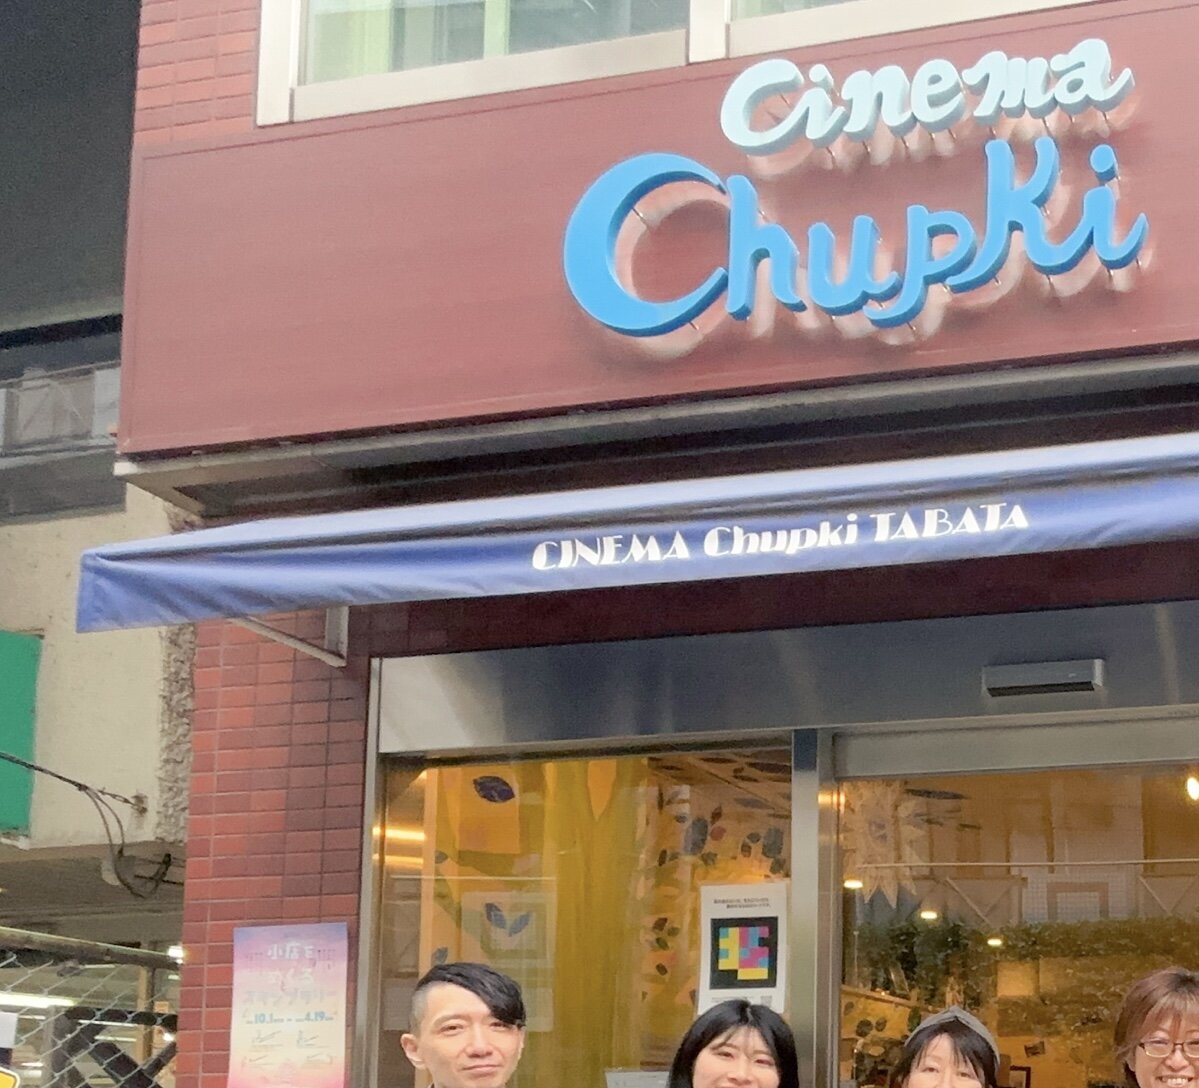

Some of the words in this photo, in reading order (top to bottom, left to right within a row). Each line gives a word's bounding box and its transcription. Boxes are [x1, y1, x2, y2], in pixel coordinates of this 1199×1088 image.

[721, 38, 1134, 155] Cinema
[532, 529, 690, 570] CINEMA
[703, 513, 858, 558] Chupki
[869, 502, 1029, 543] TABATA
